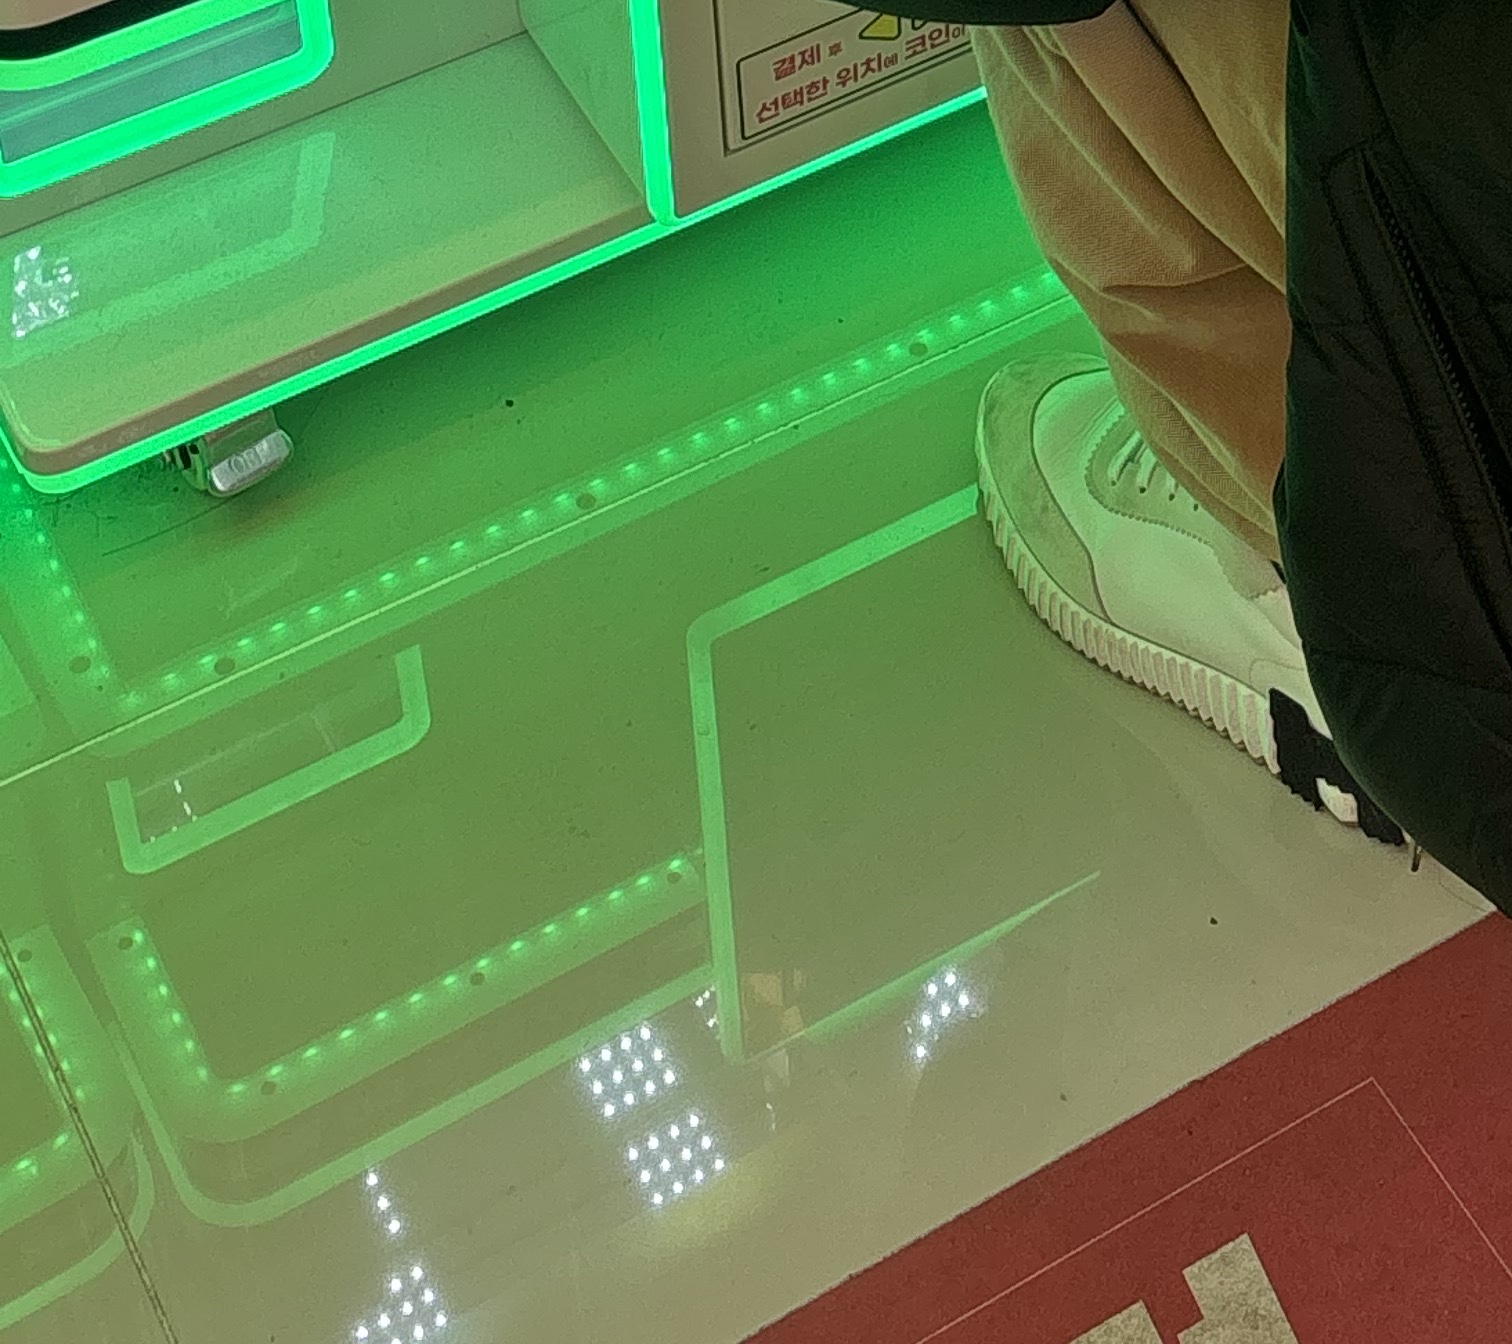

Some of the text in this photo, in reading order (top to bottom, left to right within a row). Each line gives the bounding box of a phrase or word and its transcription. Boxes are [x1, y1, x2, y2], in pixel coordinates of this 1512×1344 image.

[755, 77, 830, 124] 선택한
[835, 52, 899, 88] 위치에
[772, 43, 822, 80] 결제
